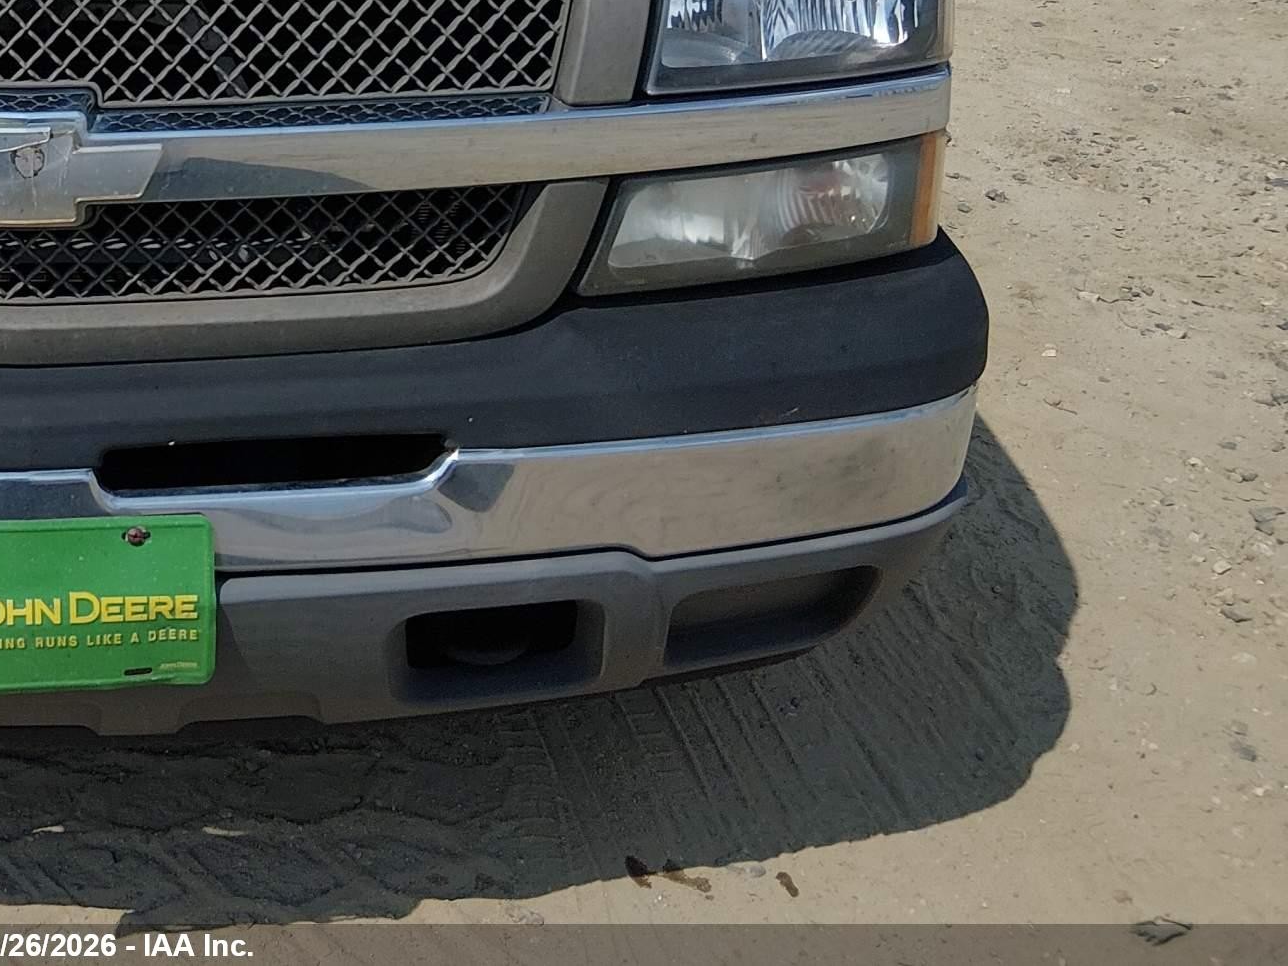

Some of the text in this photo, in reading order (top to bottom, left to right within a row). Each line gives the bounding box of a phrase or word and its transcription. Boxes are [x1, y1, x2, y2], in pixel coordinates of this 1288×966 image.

[69, 591, 199, 625] DEERE
[35, 636, 78, 648] RUNS
[87, 634, 123, 647] LIKE
[130, 633, 140, 644] A
[148, 629, 199, 641] DEERE
